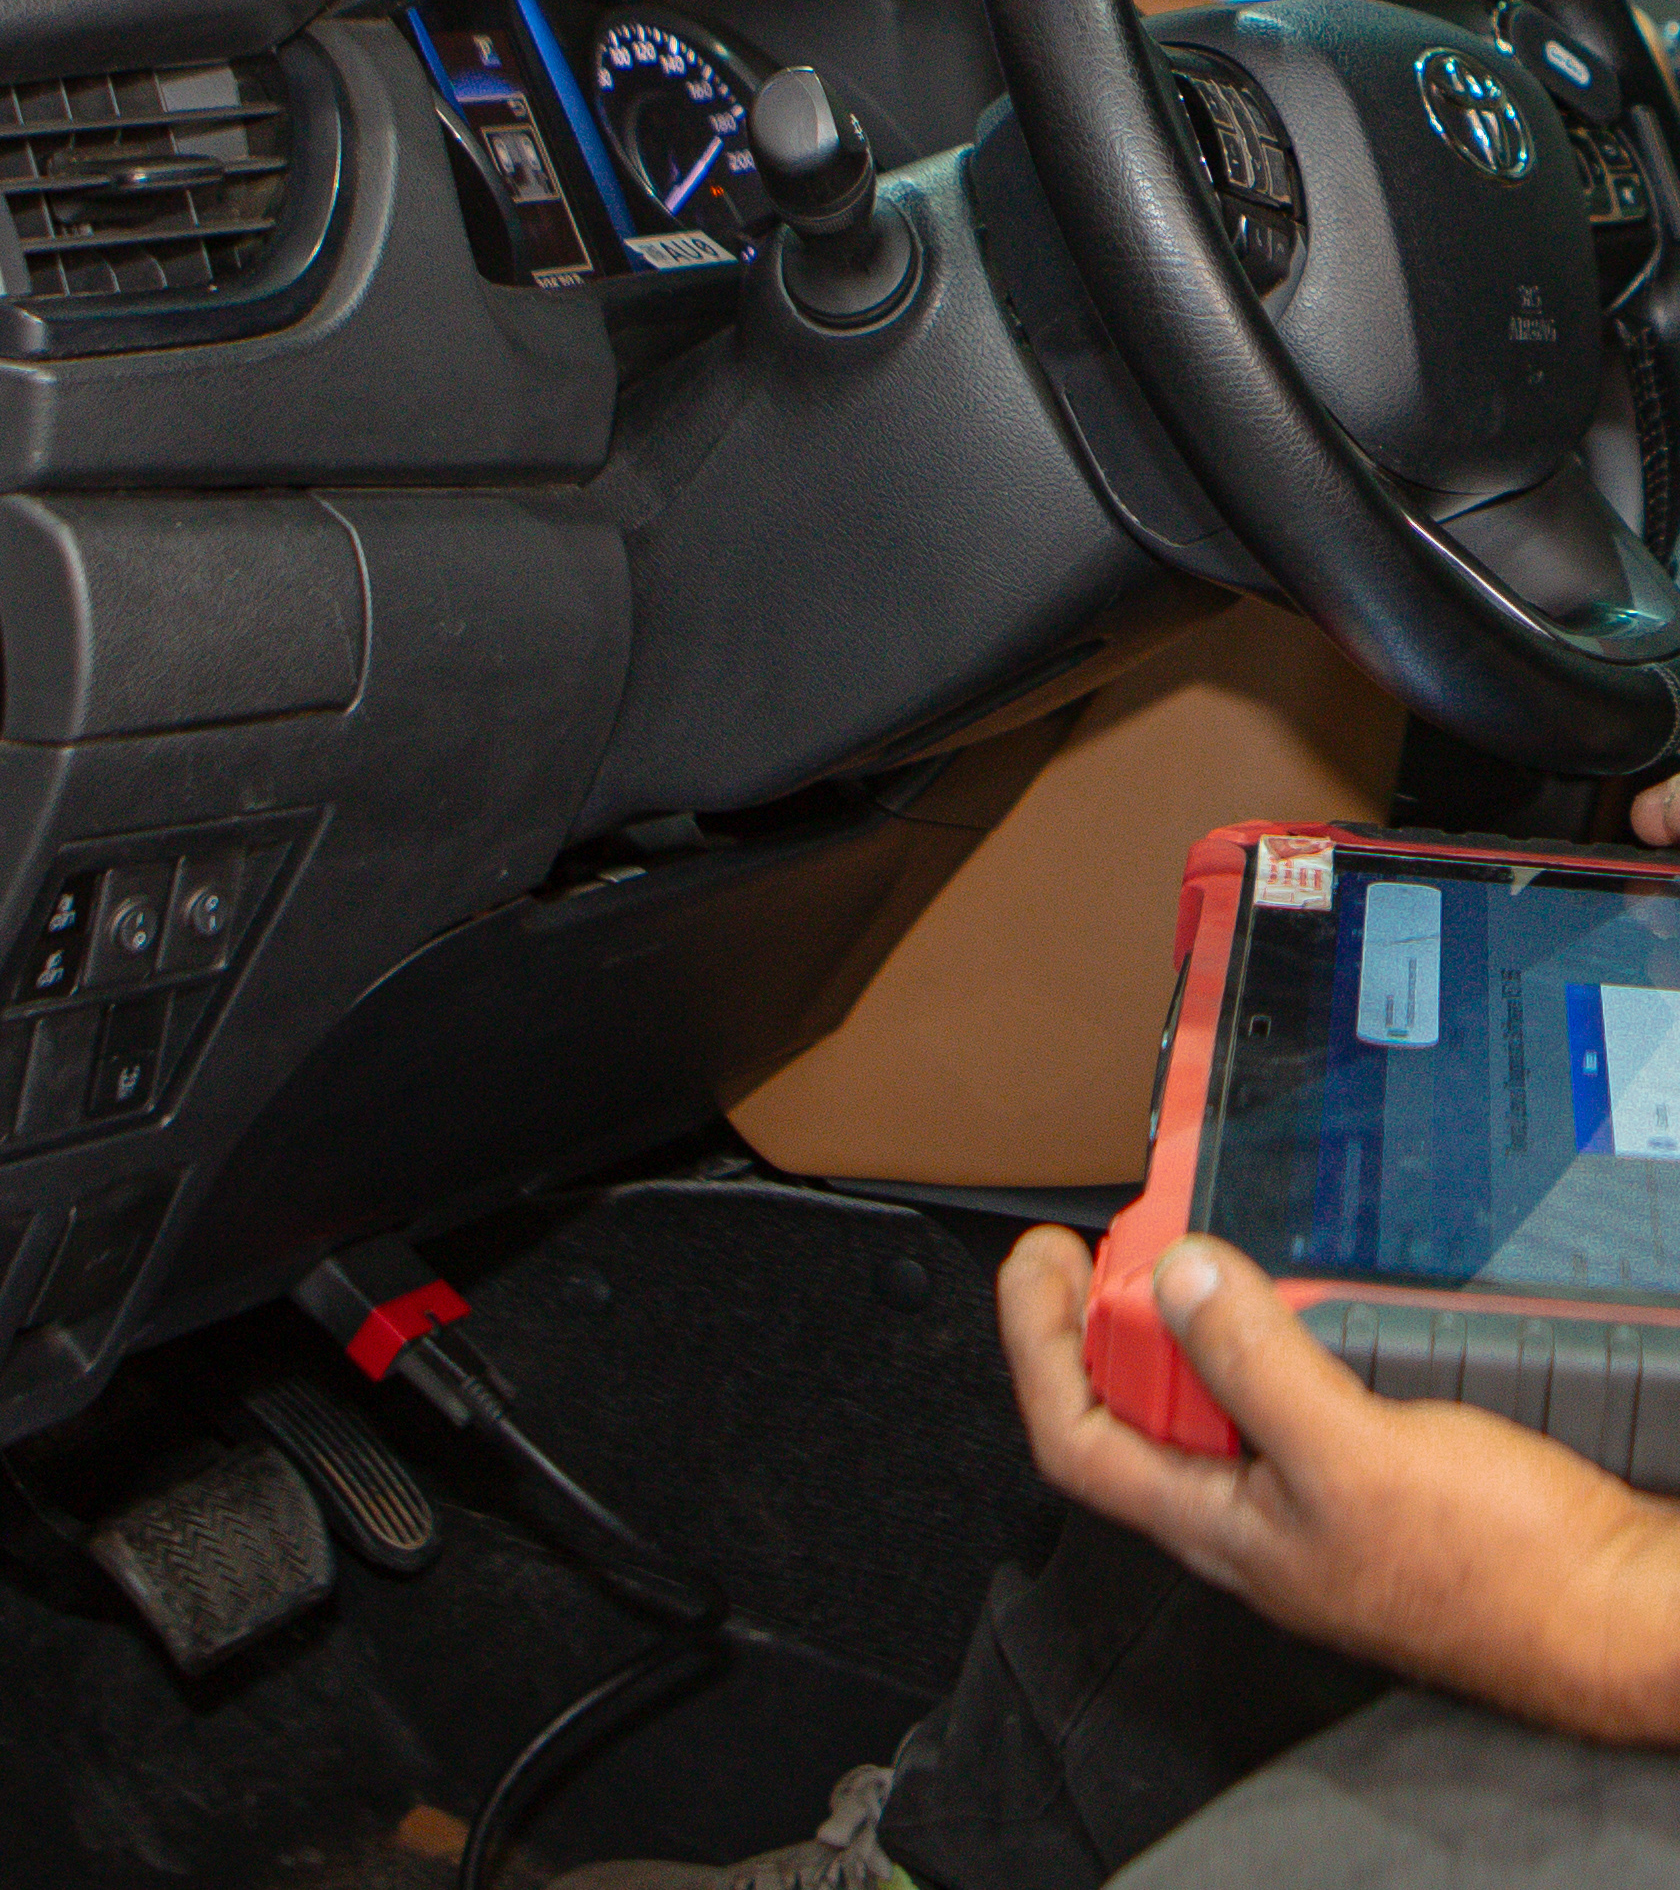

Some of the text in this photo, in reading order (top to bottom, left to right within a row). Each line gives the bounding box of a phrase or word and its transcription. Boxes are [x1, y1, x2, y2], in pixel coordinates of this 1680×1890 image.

[632, 41, 657, 64] 120
[660, 55, 687, 77] 140
[709, 112, 738, 134] 180
[726, 149, 756, 173] 200
